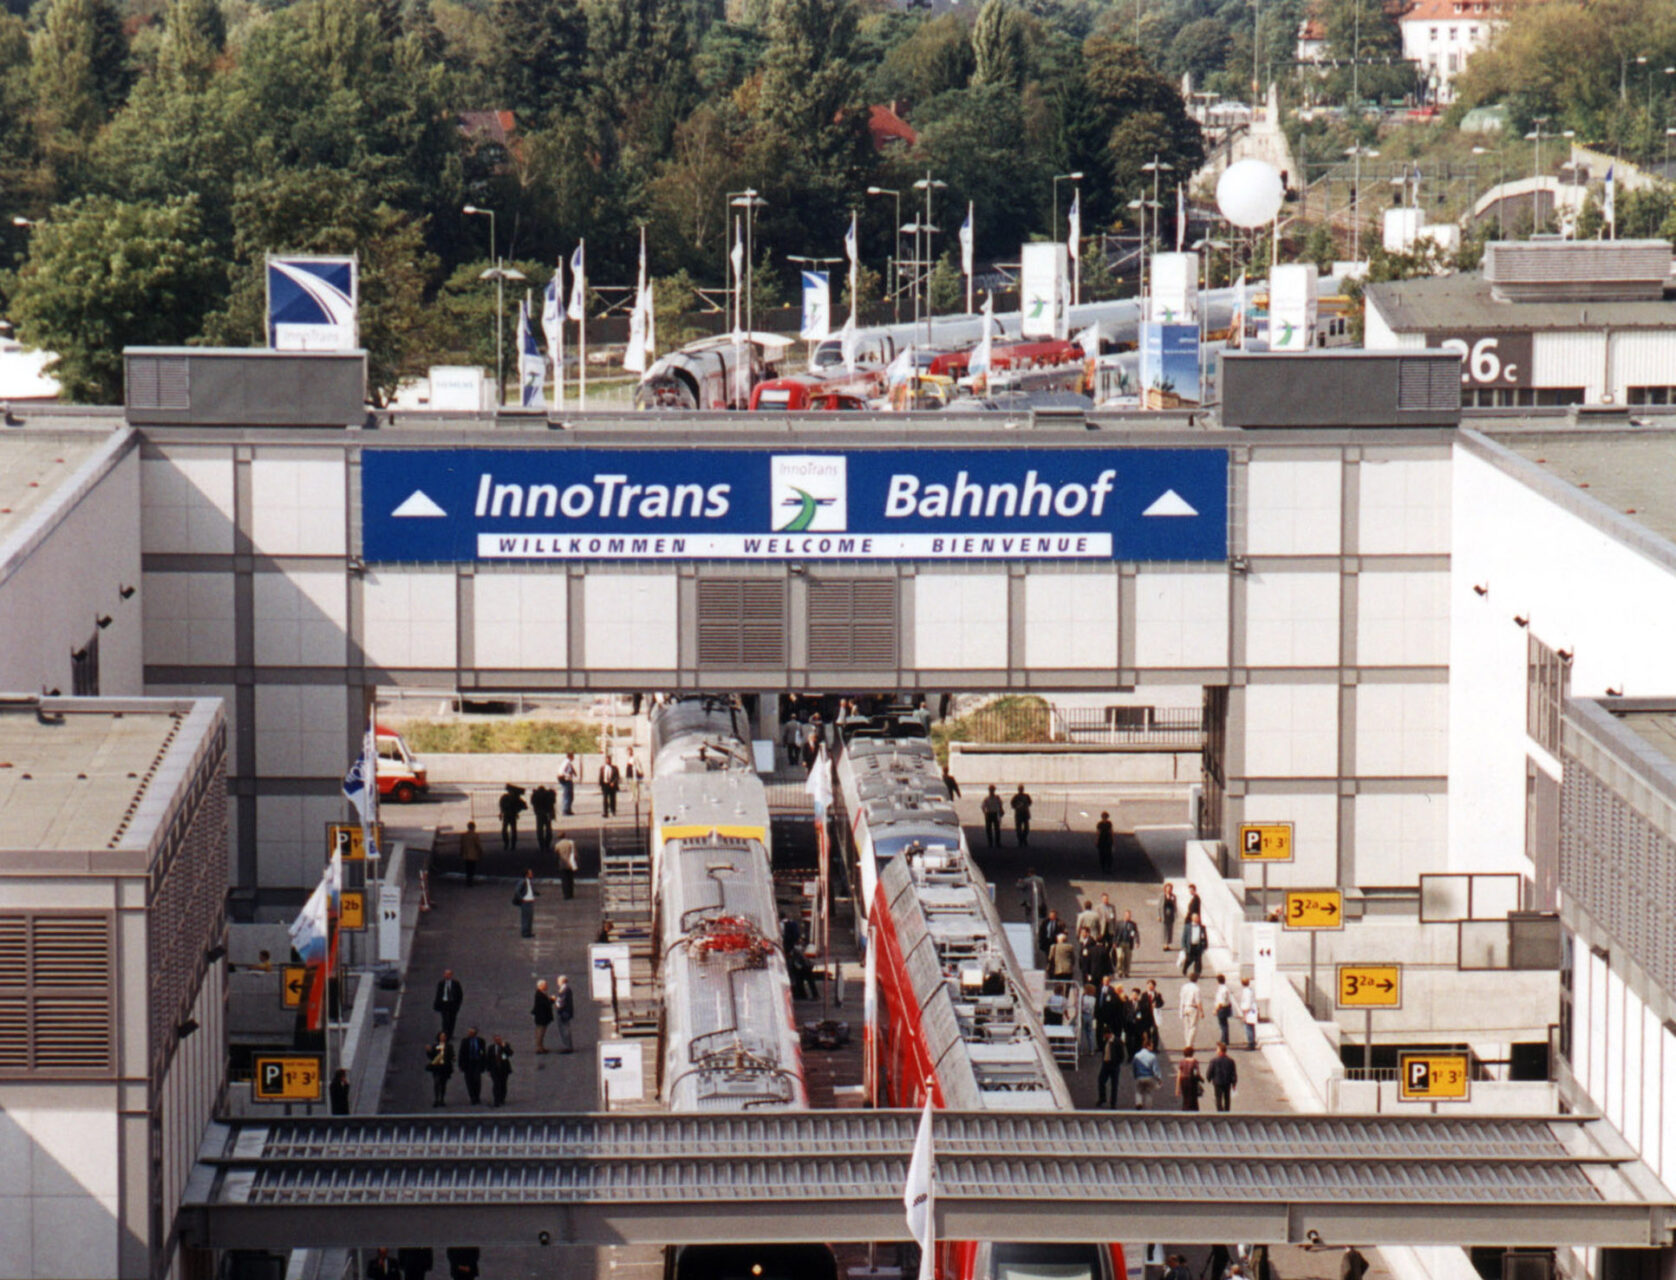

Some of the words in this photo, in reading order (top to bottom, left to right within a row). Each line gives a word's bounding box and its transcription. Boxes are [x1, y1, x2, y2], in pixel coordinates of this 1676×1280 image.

[779, 462, 838, 476] InnoTrans
[475, 473, 731, 517] InnoTrans
[885, 469, 1116, 517] Bahnhof
[499, 538, 686, 553] WILLKOMMEN
[744, 538, 873, 553] WELCOME
[932, 537, 1088, 553] BIENVENUE
[1247, 831, 1260, 849] P
[266, 1065, 279, 1085] P
[1412, 1063, 1427, 1084] P
